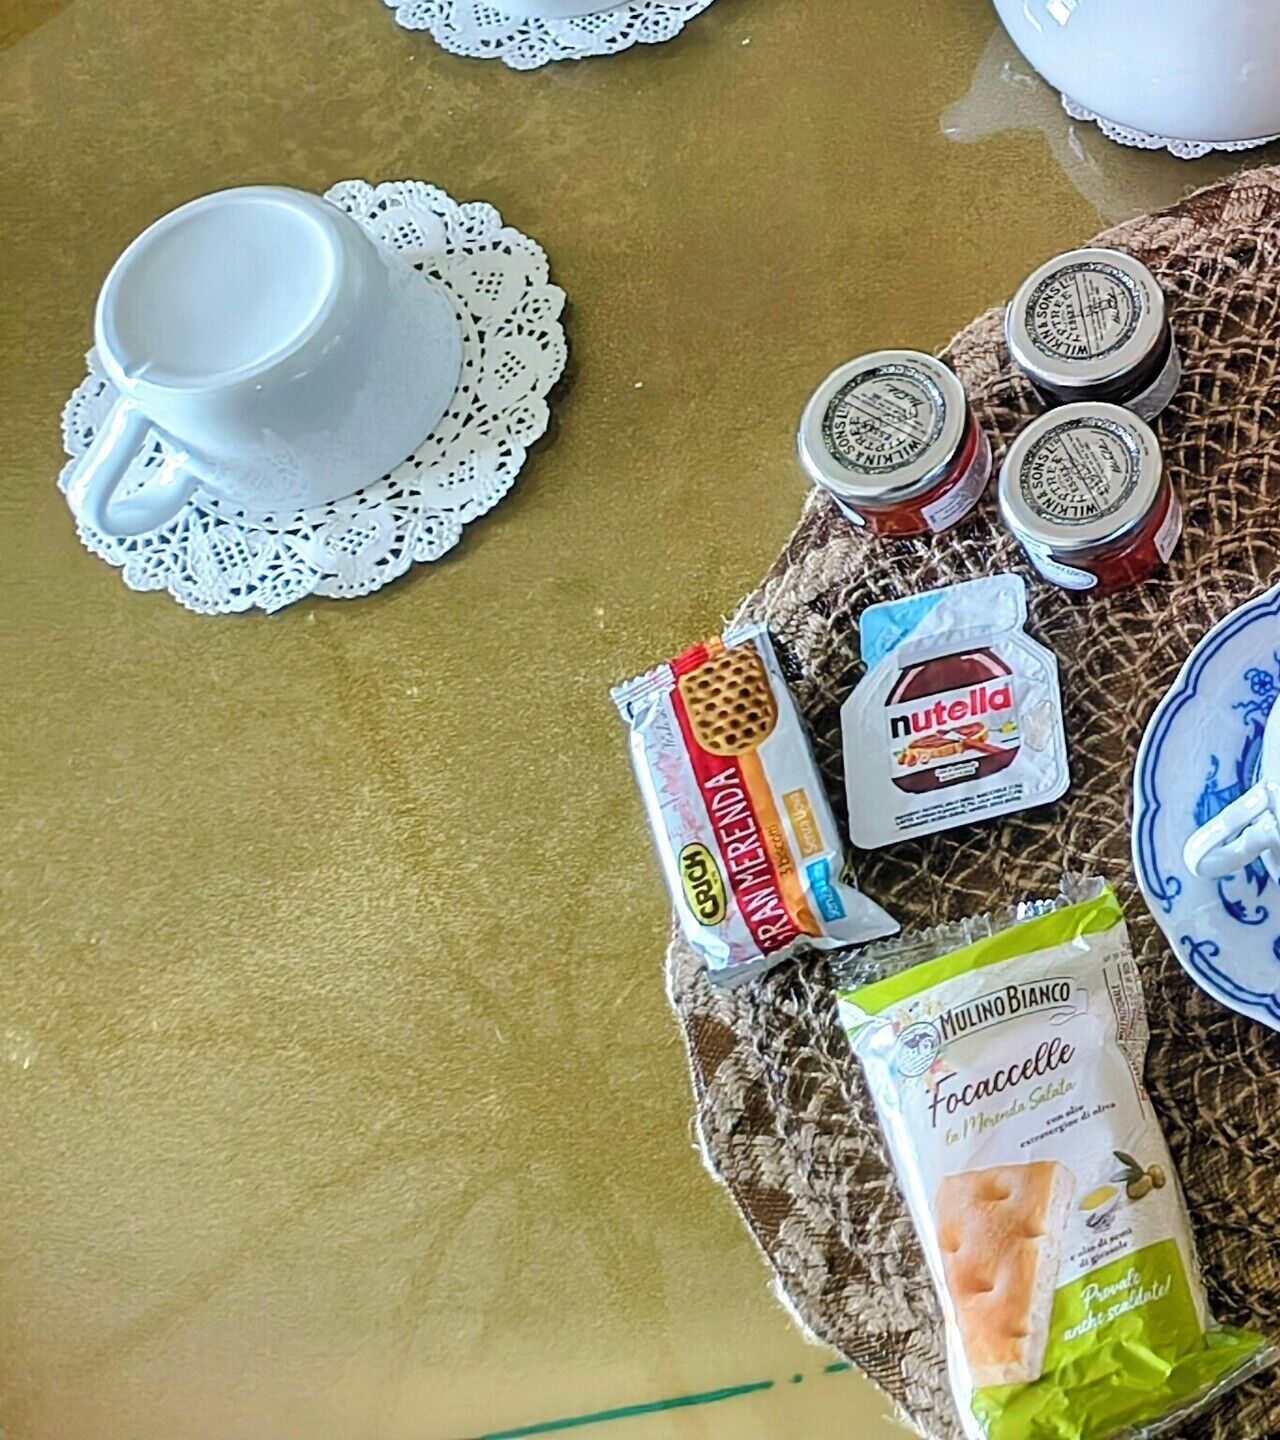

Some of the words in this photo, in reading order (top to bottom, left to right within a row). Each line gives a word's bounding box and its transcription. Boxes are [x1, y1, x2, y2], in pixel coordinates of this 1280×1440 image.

[1037, 286, 1061, 320] SONS
[1040, 329, 1089, 356] WILKIN
[834, 421, 856, 456] SONS
[861, 436, 922, 467] WILKIN
[1031, 453, 1050, 489] SONS
[1042, 496, 1098, 518] WILKIN
[890, 686, 1012, 739] nutella
[703, 766, 772, 893] MERENDA
[682, 849, 720, 920] CRICH
[938, 996, 1004, 1041] MULINO
[1005, 981, 1071, 1014] BIANCO
[928, 1036, 1076, 1128] Focaccelle
[1028, 1077, 1077, 1111] Salata
